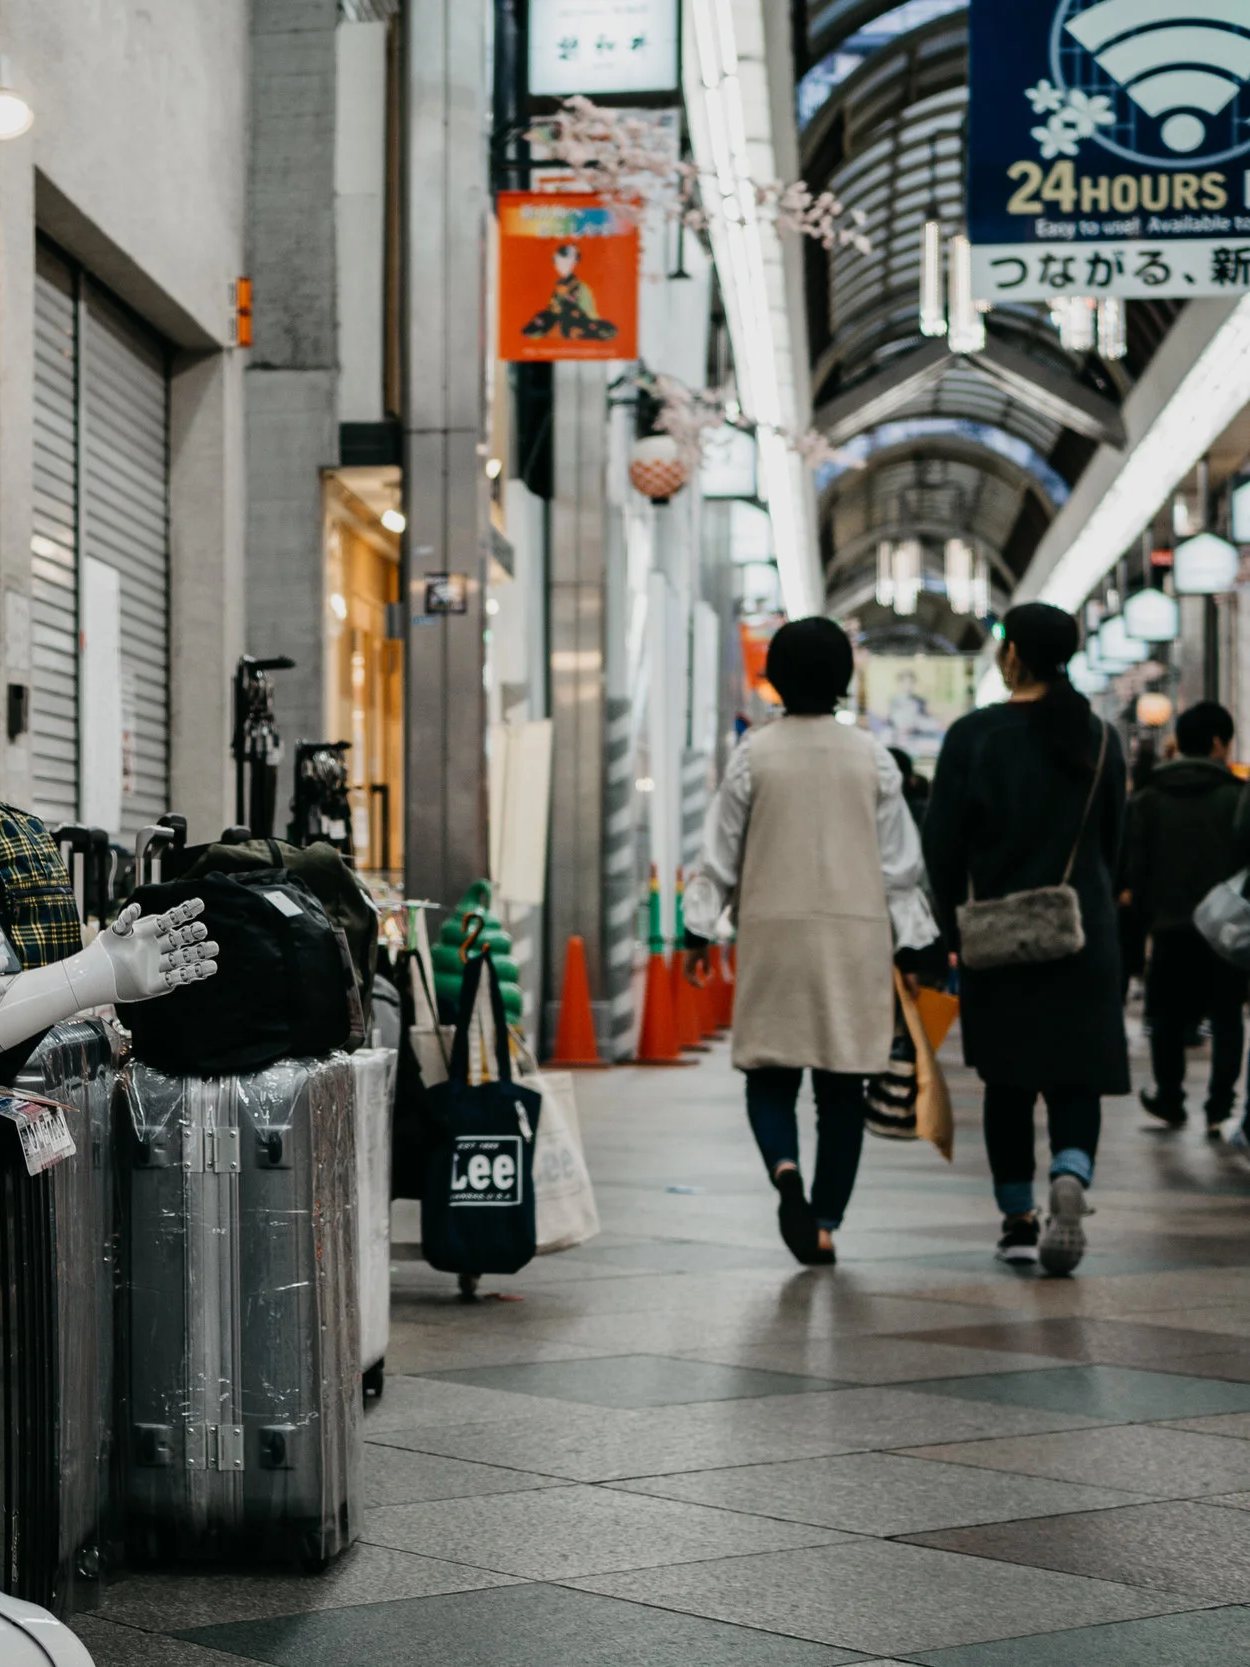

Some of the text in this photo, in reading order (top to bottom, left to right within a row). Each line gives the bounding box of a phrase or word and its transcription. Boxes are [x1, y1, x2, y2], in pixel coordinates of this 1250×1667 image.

[1035, 219, 1075, 239] Easy
[1079, 220, 1100, 236] to
[1147, 214, 1232, 233] Available
[451, 1153, 515, 1190] Lee
